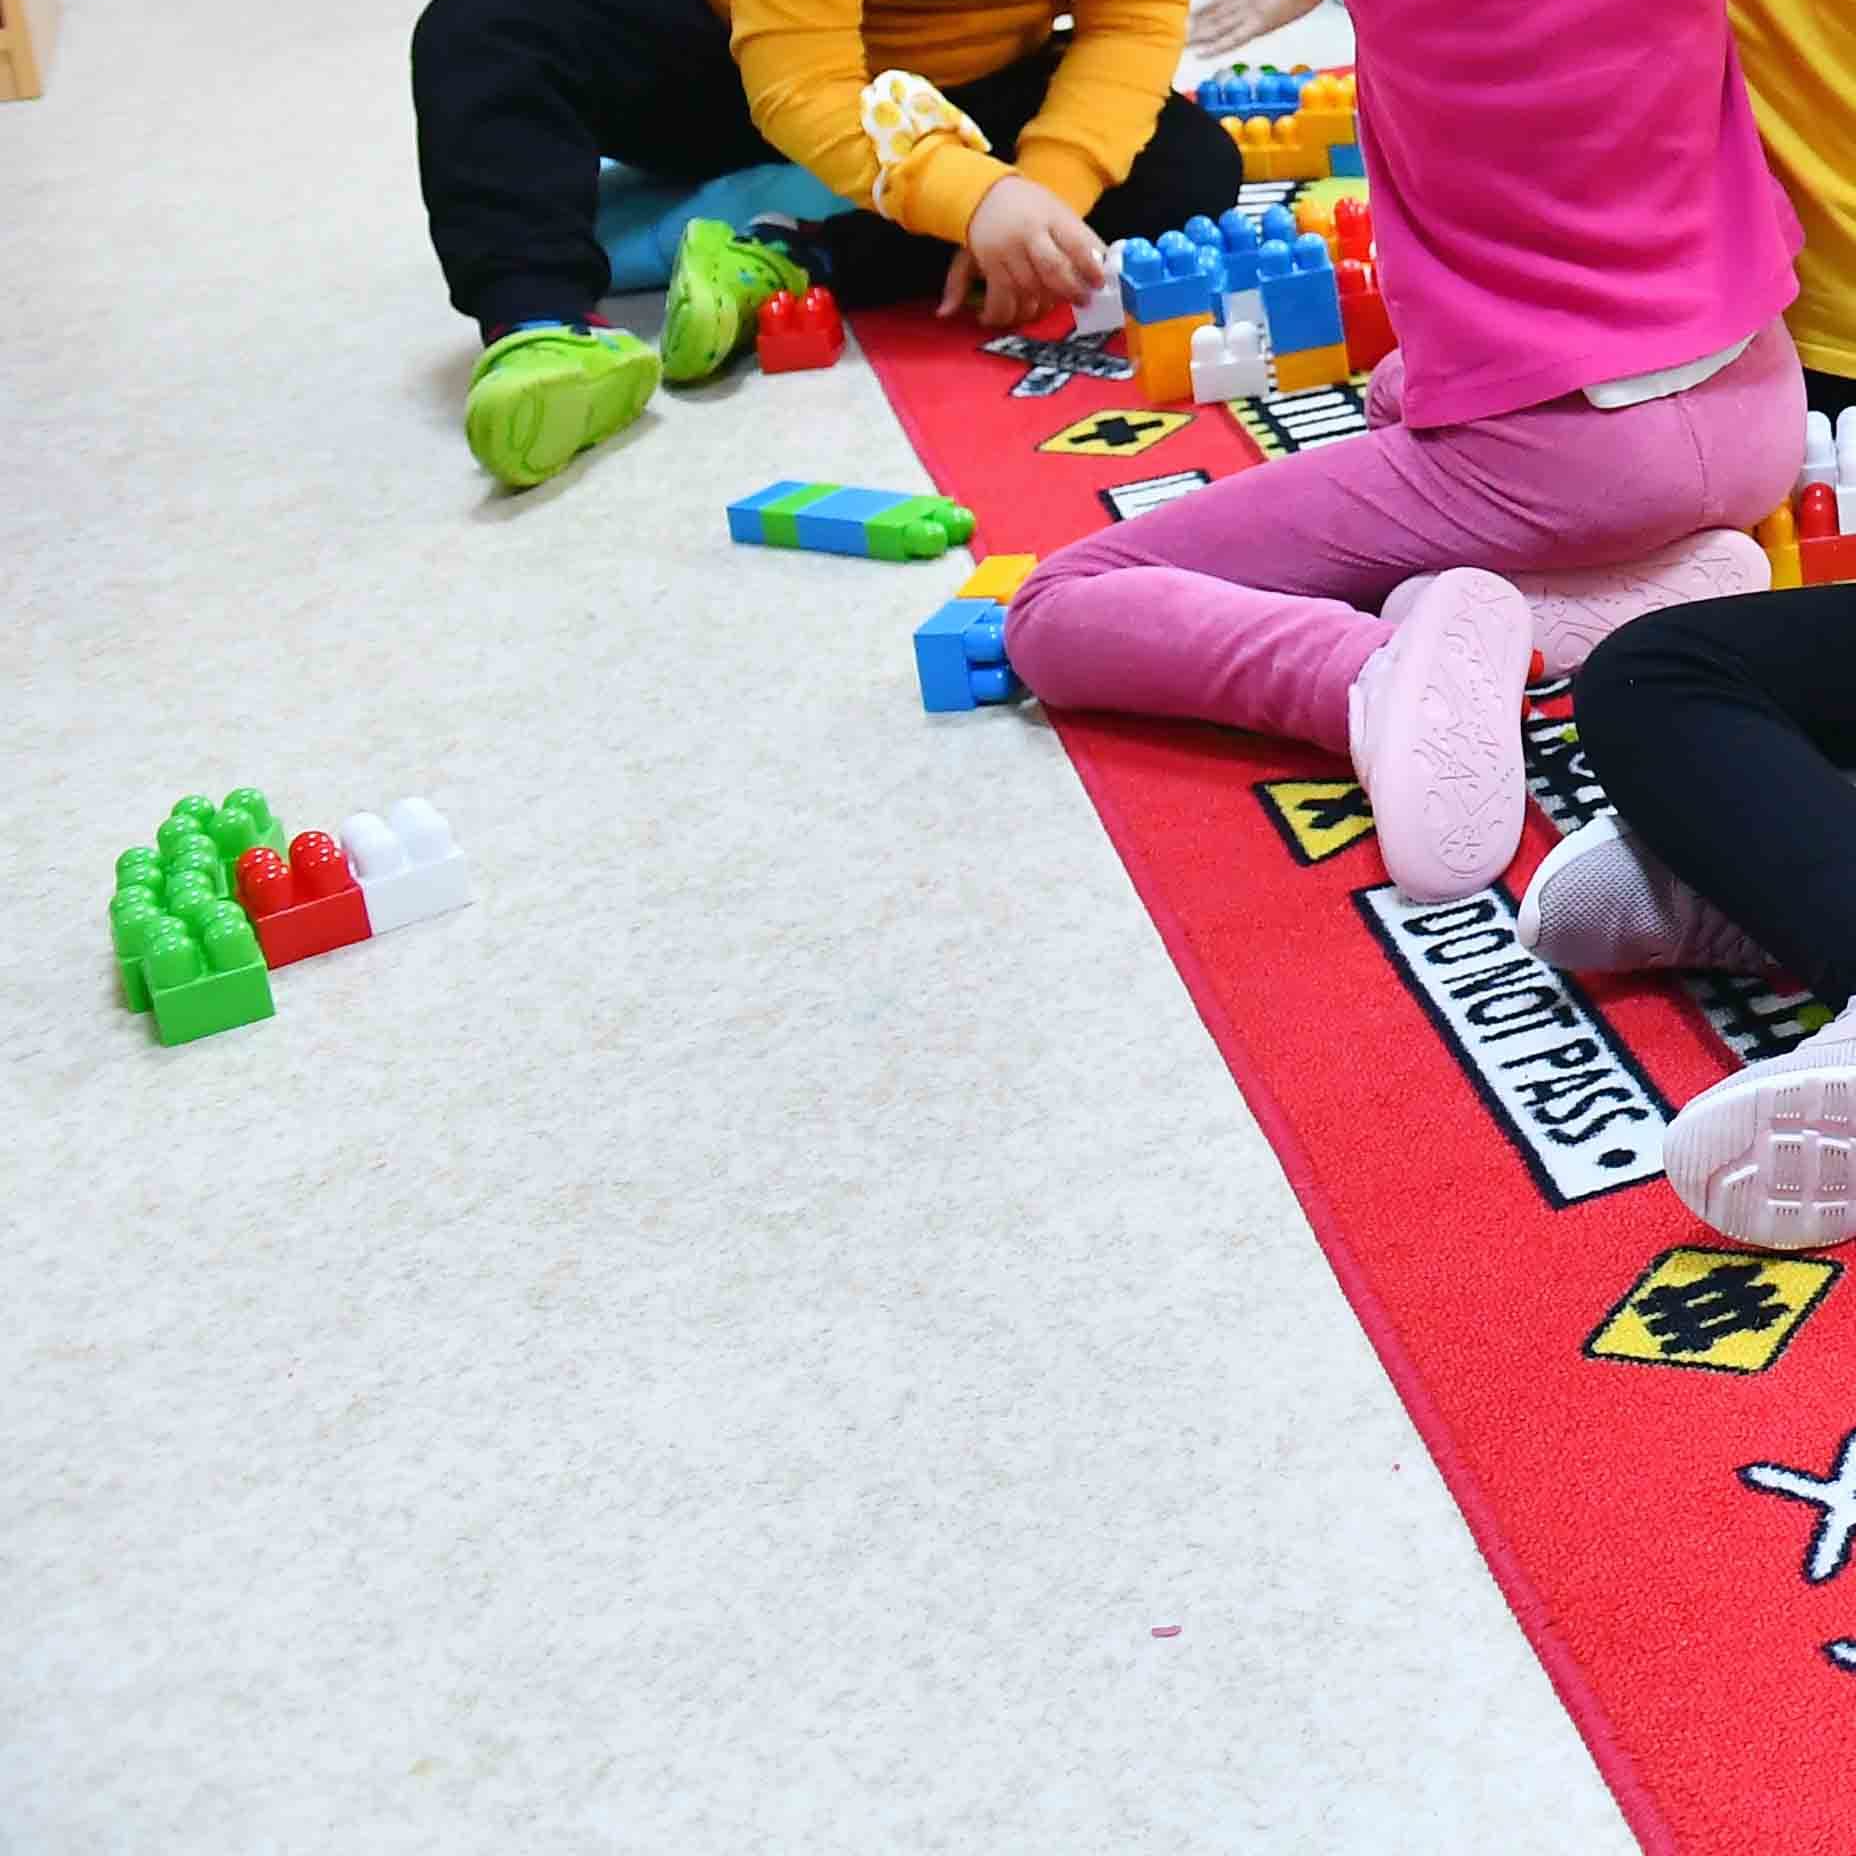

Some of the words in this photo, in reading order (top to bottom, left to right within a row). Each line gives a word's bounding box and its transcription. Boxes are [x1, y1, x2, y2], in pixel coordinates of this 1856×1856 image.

[1401, 898, 1516, 966] DO
[1440, 956, 1581, 1044] NOT
[1497, 1037, 1651, 1146] PASS
